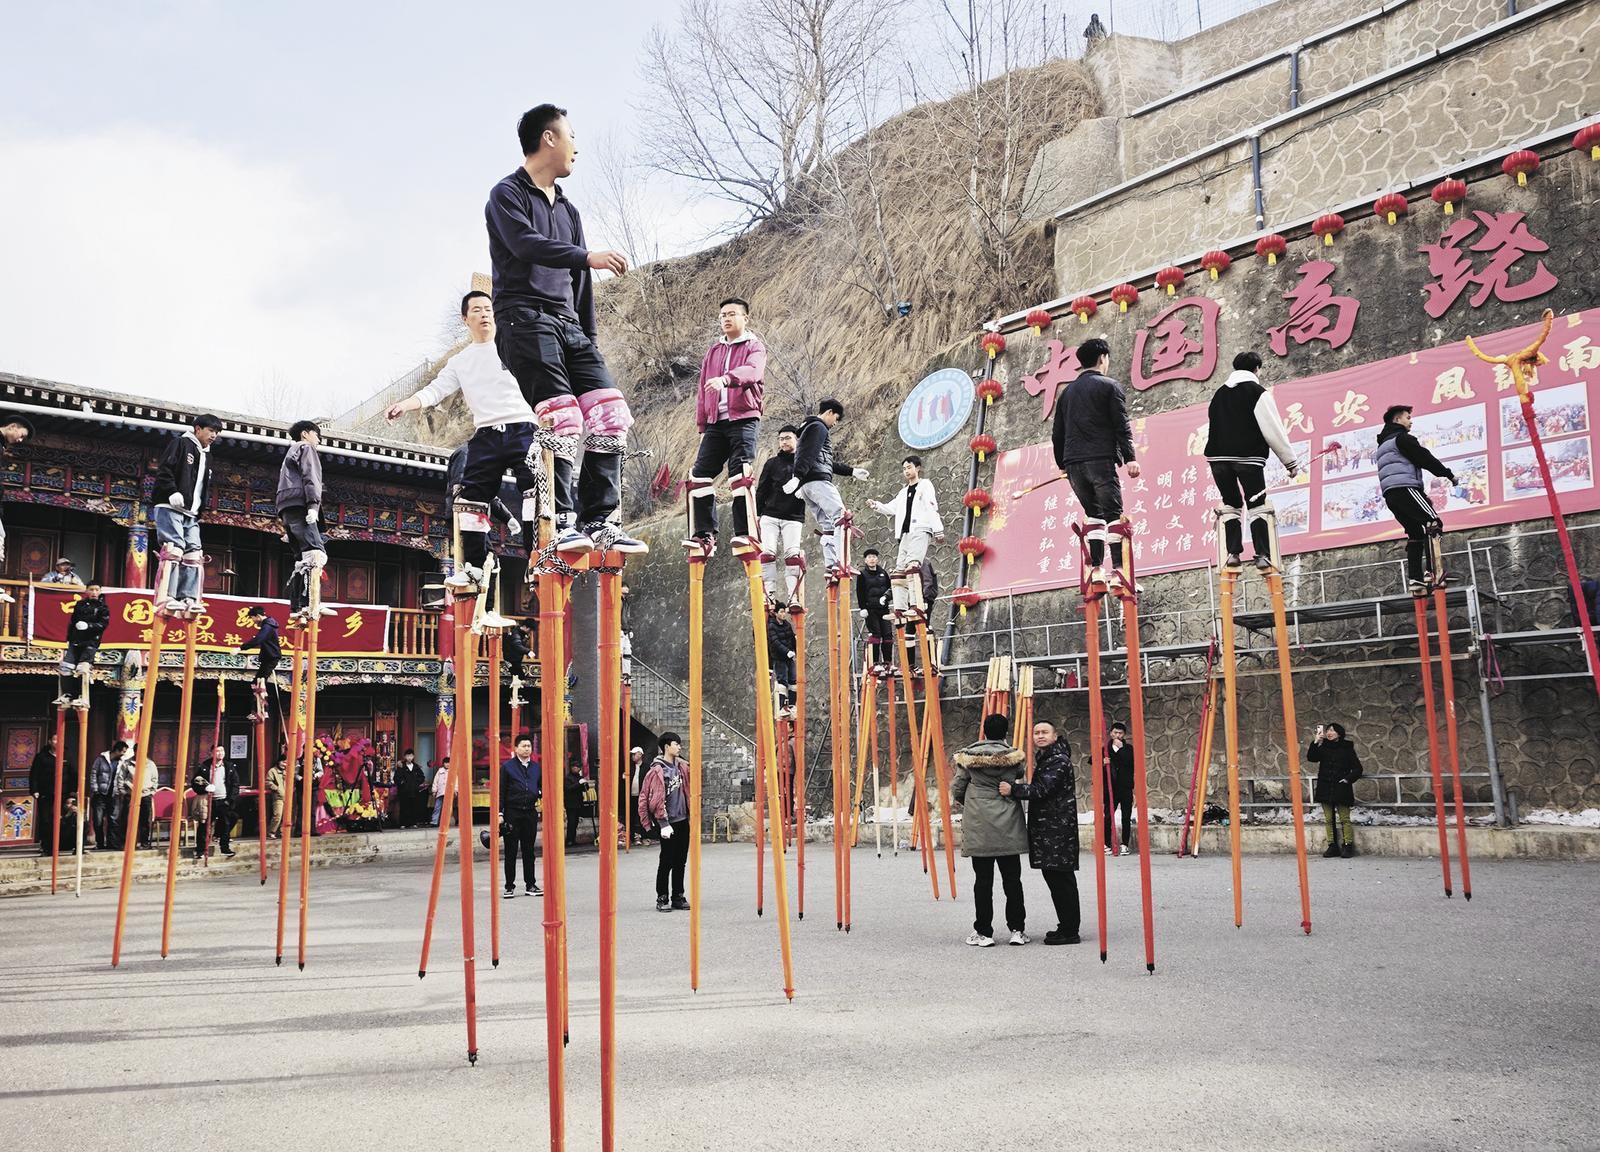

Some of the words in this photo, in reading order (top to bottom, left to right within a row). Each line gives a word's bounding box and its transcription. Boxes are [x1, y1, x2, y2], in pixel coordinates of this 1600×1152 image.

[1020, 210, 1559, 421] 中国高跷
[1041, 484, 1223, 531] 挖掘文化精髓
[1044, 465, 1215, 511] 继承文明传
[1037, 532, 1217, 574] 重建精神信仰
[1039, 508, 1216, 552] 弘扬统文化
